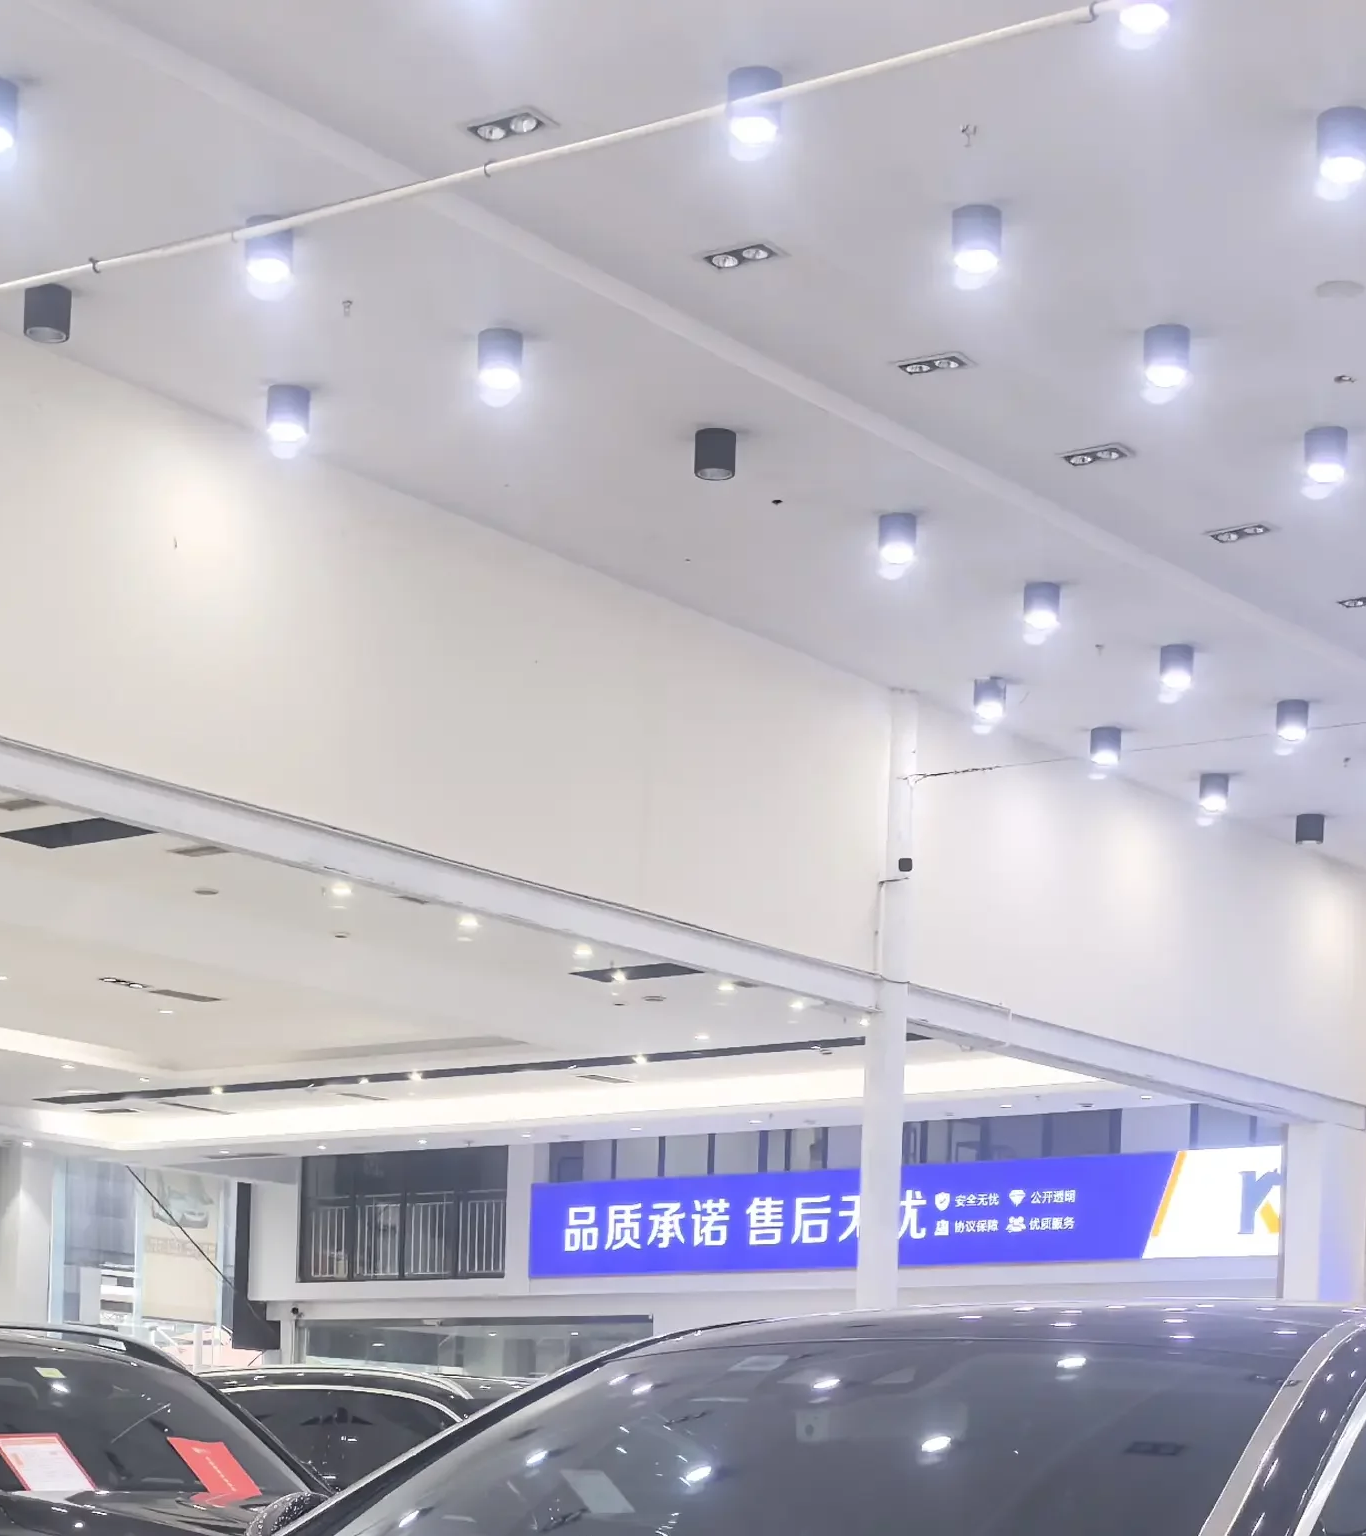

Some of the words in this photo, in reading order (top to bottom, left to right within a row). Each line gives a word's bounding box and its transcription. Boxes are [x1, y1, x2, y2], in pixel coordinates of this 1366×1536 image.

[1030, 1189, 1076, 1205] 公开透明
[564, 1198, 730, 1252] 品质承诺
